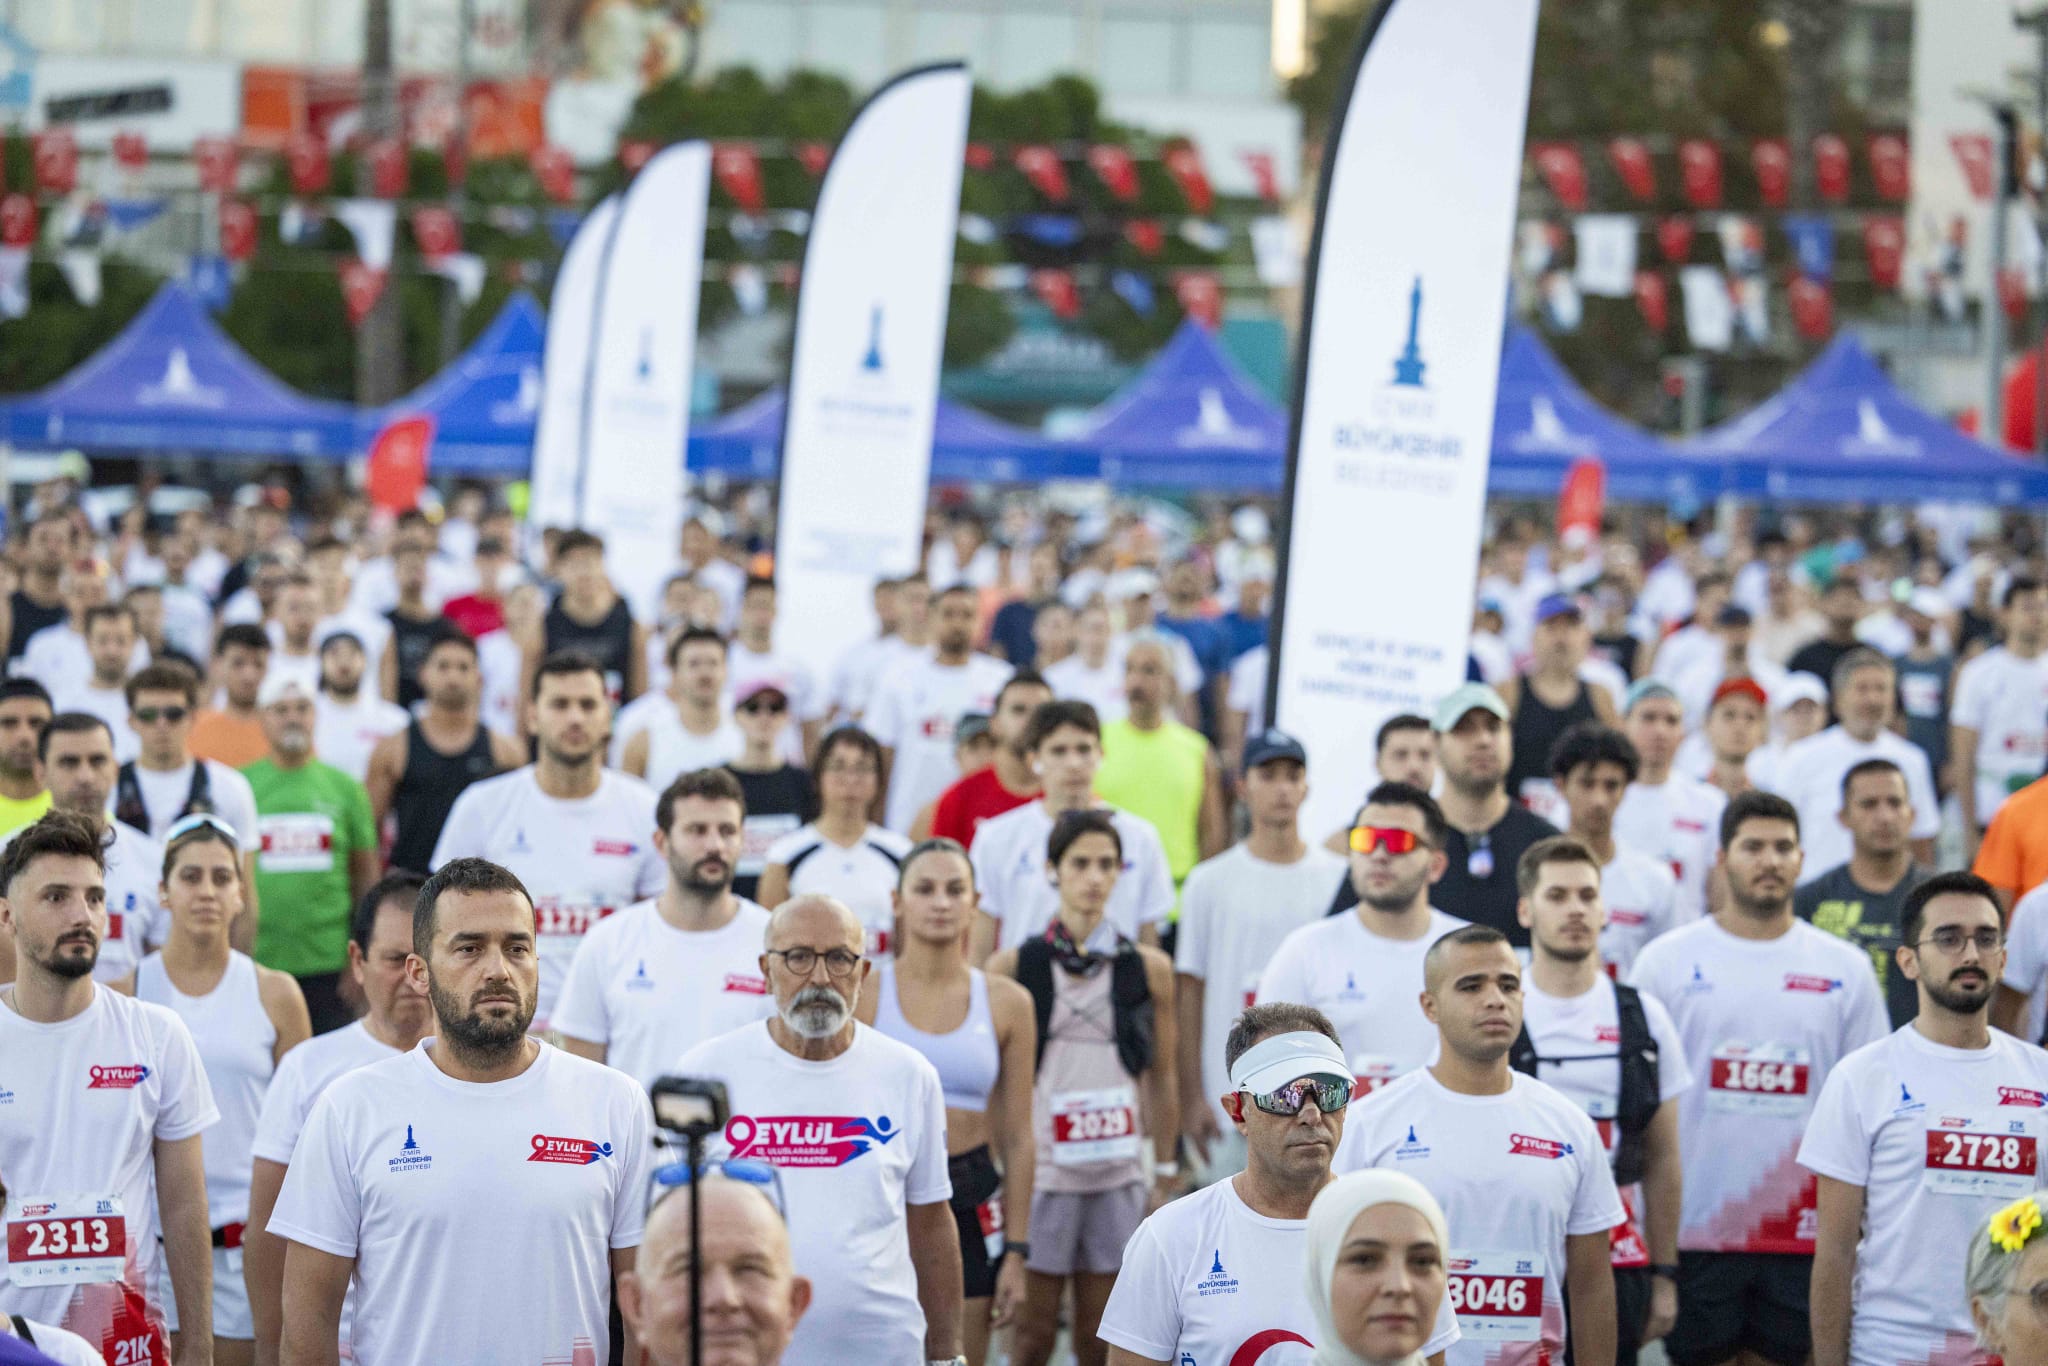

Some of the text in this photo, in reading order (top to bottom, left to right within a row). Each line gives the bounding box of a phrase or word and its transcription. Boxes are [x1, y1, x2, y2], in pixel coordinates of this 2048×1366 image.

[1725, 1061, 1795, 1091] 1664
[753, 1122, 834, 1145] EYLÜL
[1066, 1109, 1127, 1140] 2029
[547, 1140, 585, 1152] EYLÜL
[1942, 1133, 2020, 1169] 2728
[388, 1155, 432, 1166] BÜYÜKŞEHİR
[390, 1163, 431, 1173] BELEDİYESİ
[26, 1219, 110, 1256] 2313
[1197, 1279, 1239, 1289] BÜYÜKŞEHİR
[1200, 1288, 1238, 1296] BELEDİYESİ
[1448, 1277, 1527, 1311] 3046
[114, 1333, 153, 1365] 21K
